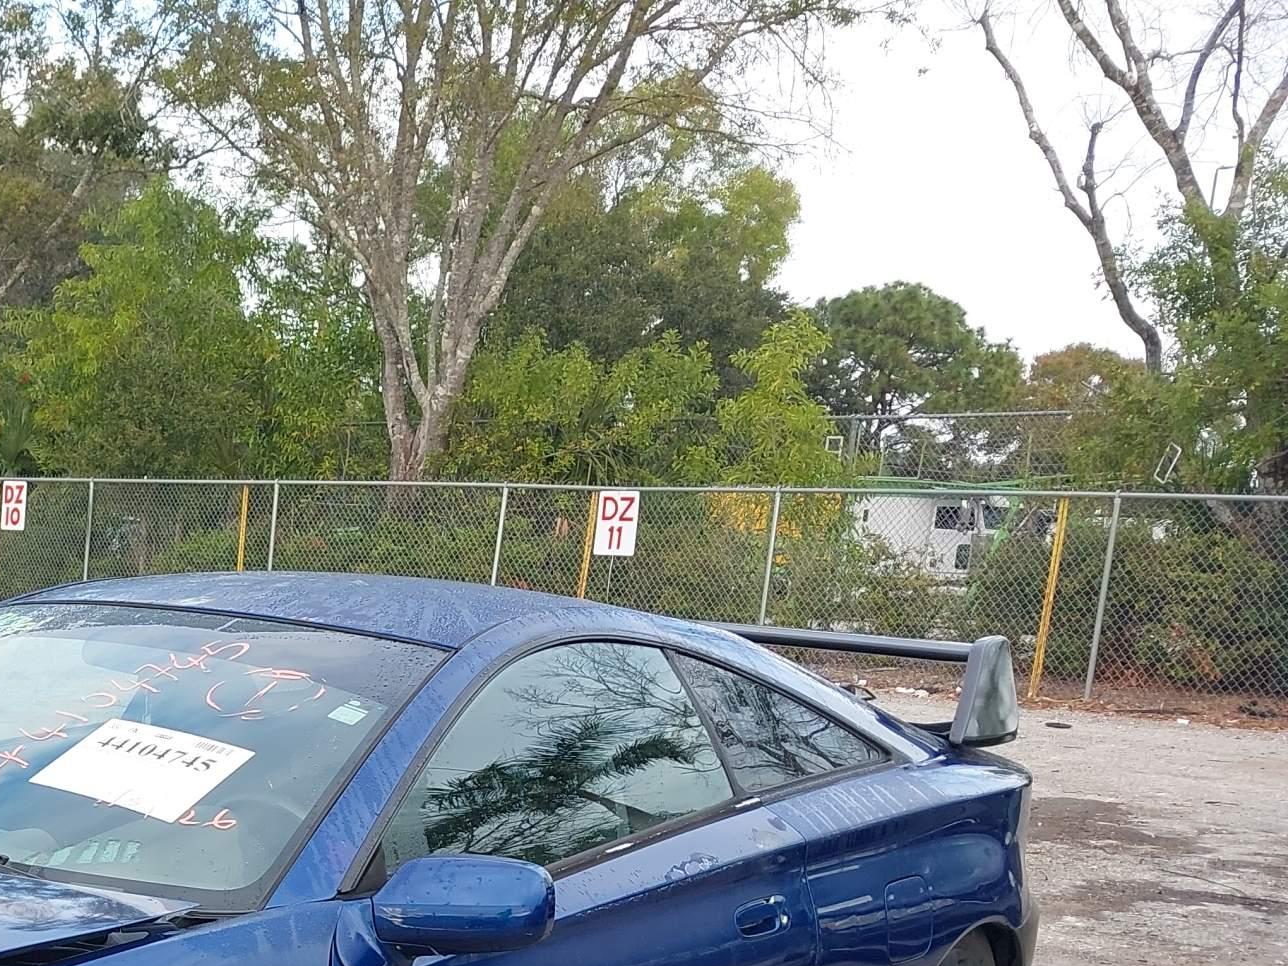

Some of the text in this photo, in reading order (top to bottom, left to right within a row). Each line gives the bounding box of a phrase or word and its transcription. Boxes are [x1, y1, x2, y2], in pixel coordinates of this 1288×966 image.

[4, 484, 25, 505] DZ
[4, 506, 21, 527] 10
[601, 496, 636, 522] DZ
[607, 525, 623, 550] 11
[97, 736, 217, 772] 44104745
